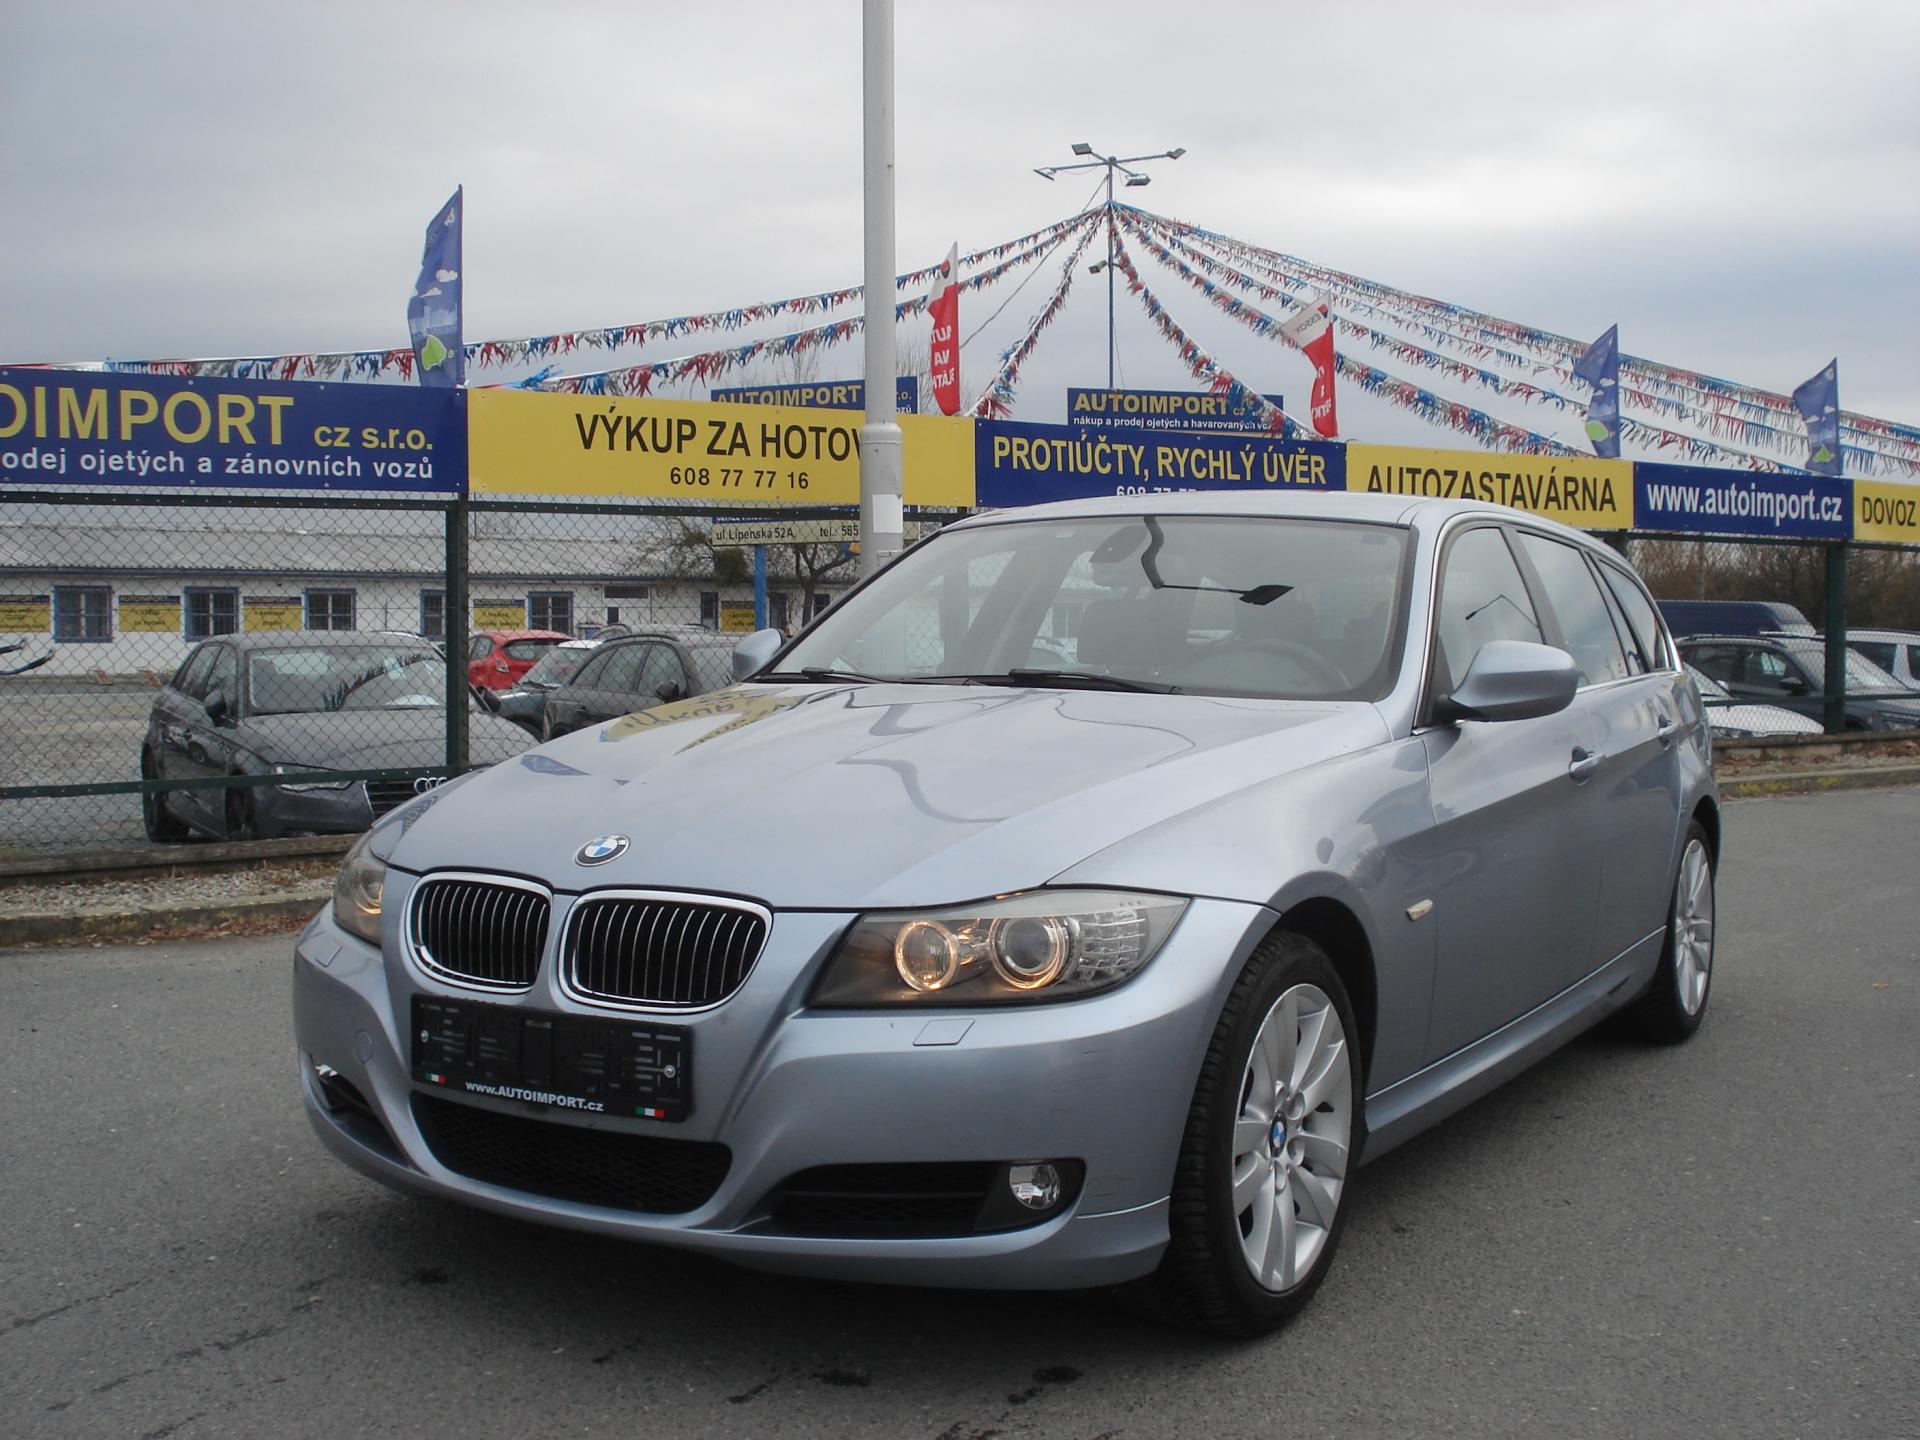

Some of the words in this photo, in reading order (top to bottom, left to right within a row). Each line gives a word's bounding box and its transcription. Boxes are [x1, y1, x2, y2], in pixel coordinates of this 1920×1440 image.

[1074, 392, 1228, 416] AUTOIMPORT
[314, 426, 350, 447] cz
[362, 427, 432, 450] s.r.o.
[575, 405, 697, 454] VÝKUP
[706, 420, 751, 457] ZA
[1073, 416, 1104, 427] nákup
[1114, 417, 1144, 429] prodej
[1147, 417, 1181, 430] ojetých
[1183, 420, 1188, 428] a
[1191, 418, 1256, 431] havarovaných
[80, 448, 184, 476] ojetých
[198, 456, 212, 473] a
[225, 452, 360, 477] zánovních
[373, 456, 432, 478] vozů
[993, 433, 1149, 481] PROTIÚČTY,
[1157, 444, 1256, 481] RYCHLÝ
[1263, 445, 1327, 484] ÚVĚR
[670, 466, 710, 486] 608
[720, 468, 743, 487] 77
[754, 470, 776, 488] 77
[787, 471, 809, 489] 16
[1367, 465, 1617, 512] AUTOZASTAVÁRNA
[1647, 482, 1843, 526] www.autoimport.cz
[1862, 496, 1917, 527] DOVOZ
[841, 524, 859, 537] 585
[465, 1081, 604, 1111] www.AUTOIMPORT.cz
